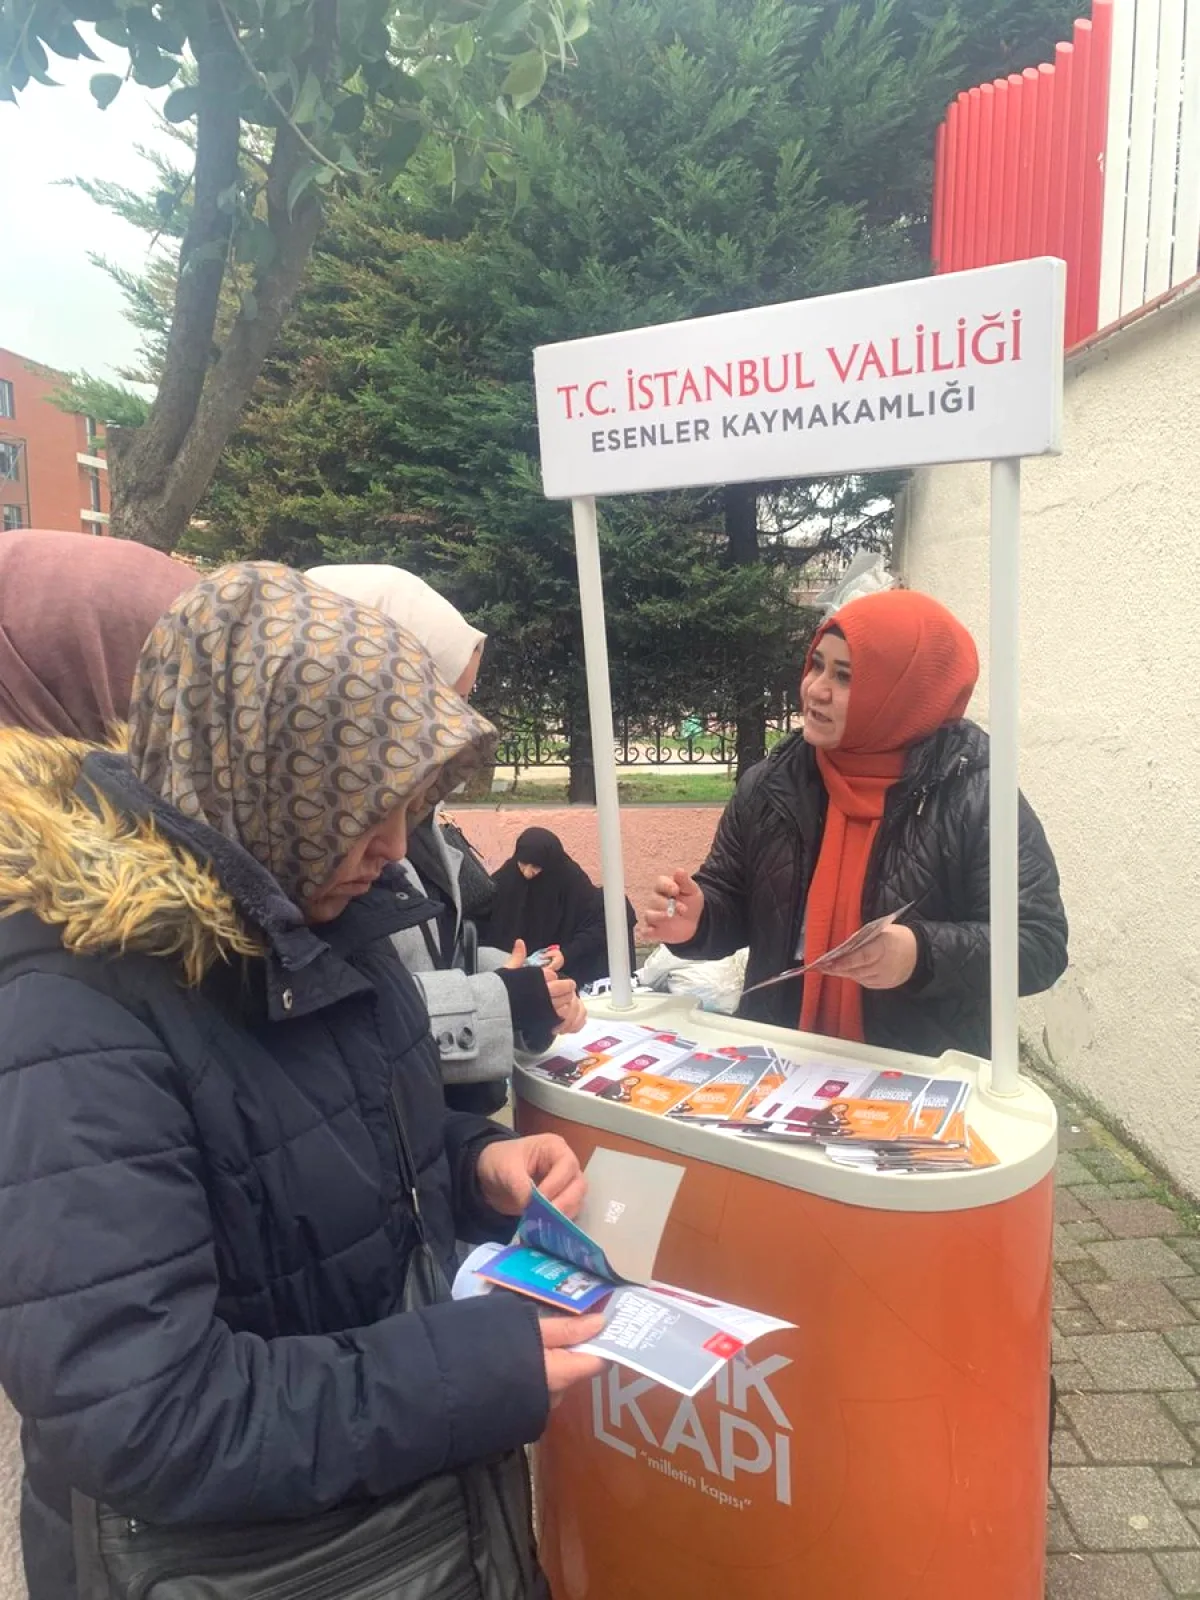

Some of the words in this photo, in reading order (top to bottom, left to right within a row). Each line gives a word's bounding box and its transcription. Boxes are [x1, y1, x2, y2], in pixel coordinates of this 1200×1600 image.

[556, 379, 617, 420] T.C.
[626, 350, 816, 412] İSTANBUL
[826, 308, 1023, 384] VALİLİĞİ
[591, 418, 711, 453] ESENLER
[722, 379, 976, 439] KAYMAKAMLIĞI
[608, 1362, 792, 1506] KAPI
